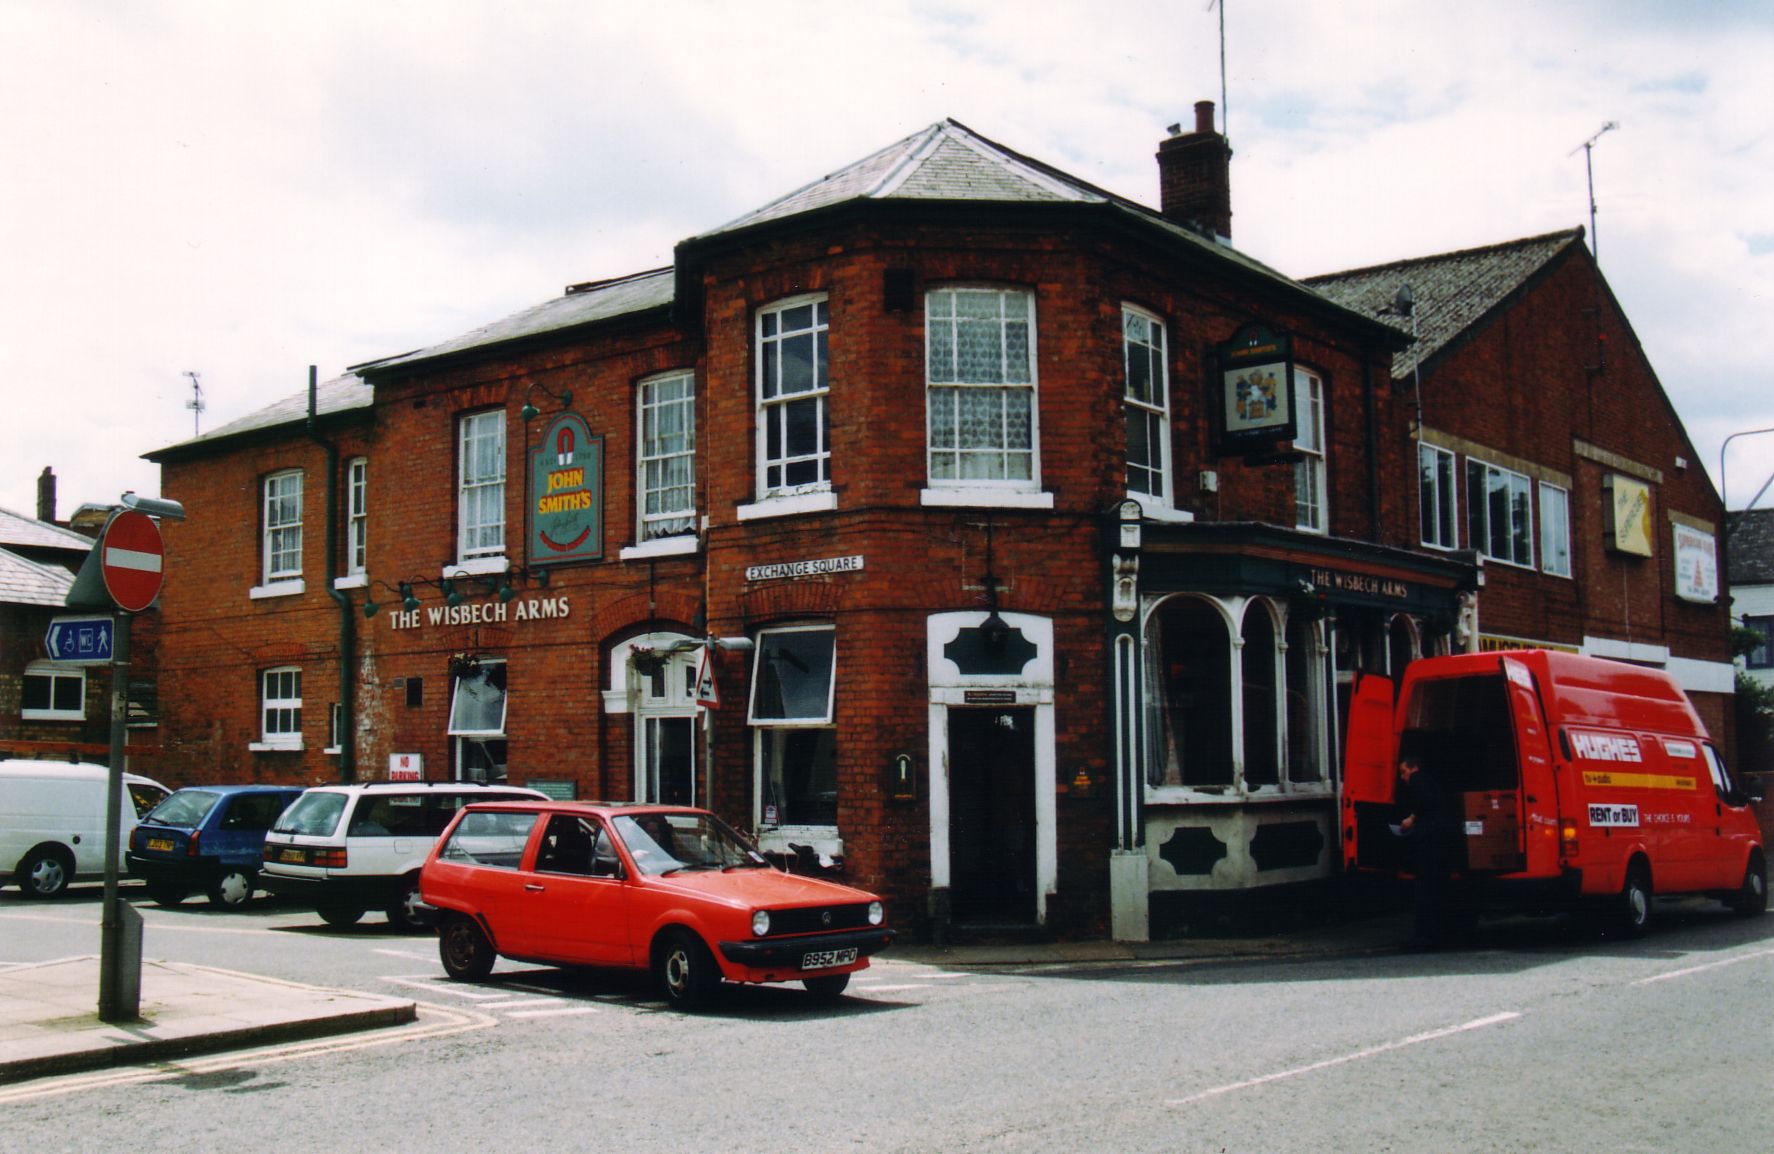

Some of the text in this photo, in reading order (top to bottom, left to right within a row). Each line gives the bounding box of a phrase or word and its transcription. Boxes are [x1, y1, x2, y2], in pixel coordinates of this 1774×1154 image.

[547, 467, 584, 494] JOHN
[538, 489, 592, 514] SMITH'S
[750, 557, 857, 579] EXCHANGE SQUARE
[1311, 569, 1408, 598] THE WISBECH ARMS
[389, 596, 570, 630] THE WISBECH ARMS
[80, 634, 92, 647] WC
[1571, 733, 1642, 762] HUGHES
[400, 756, 409, 768] NO
[391, 770, 420, 781] PARKING
[1590, 807, 1637, 823] RENT or BUY
[804, 953, 835, 967] B952
